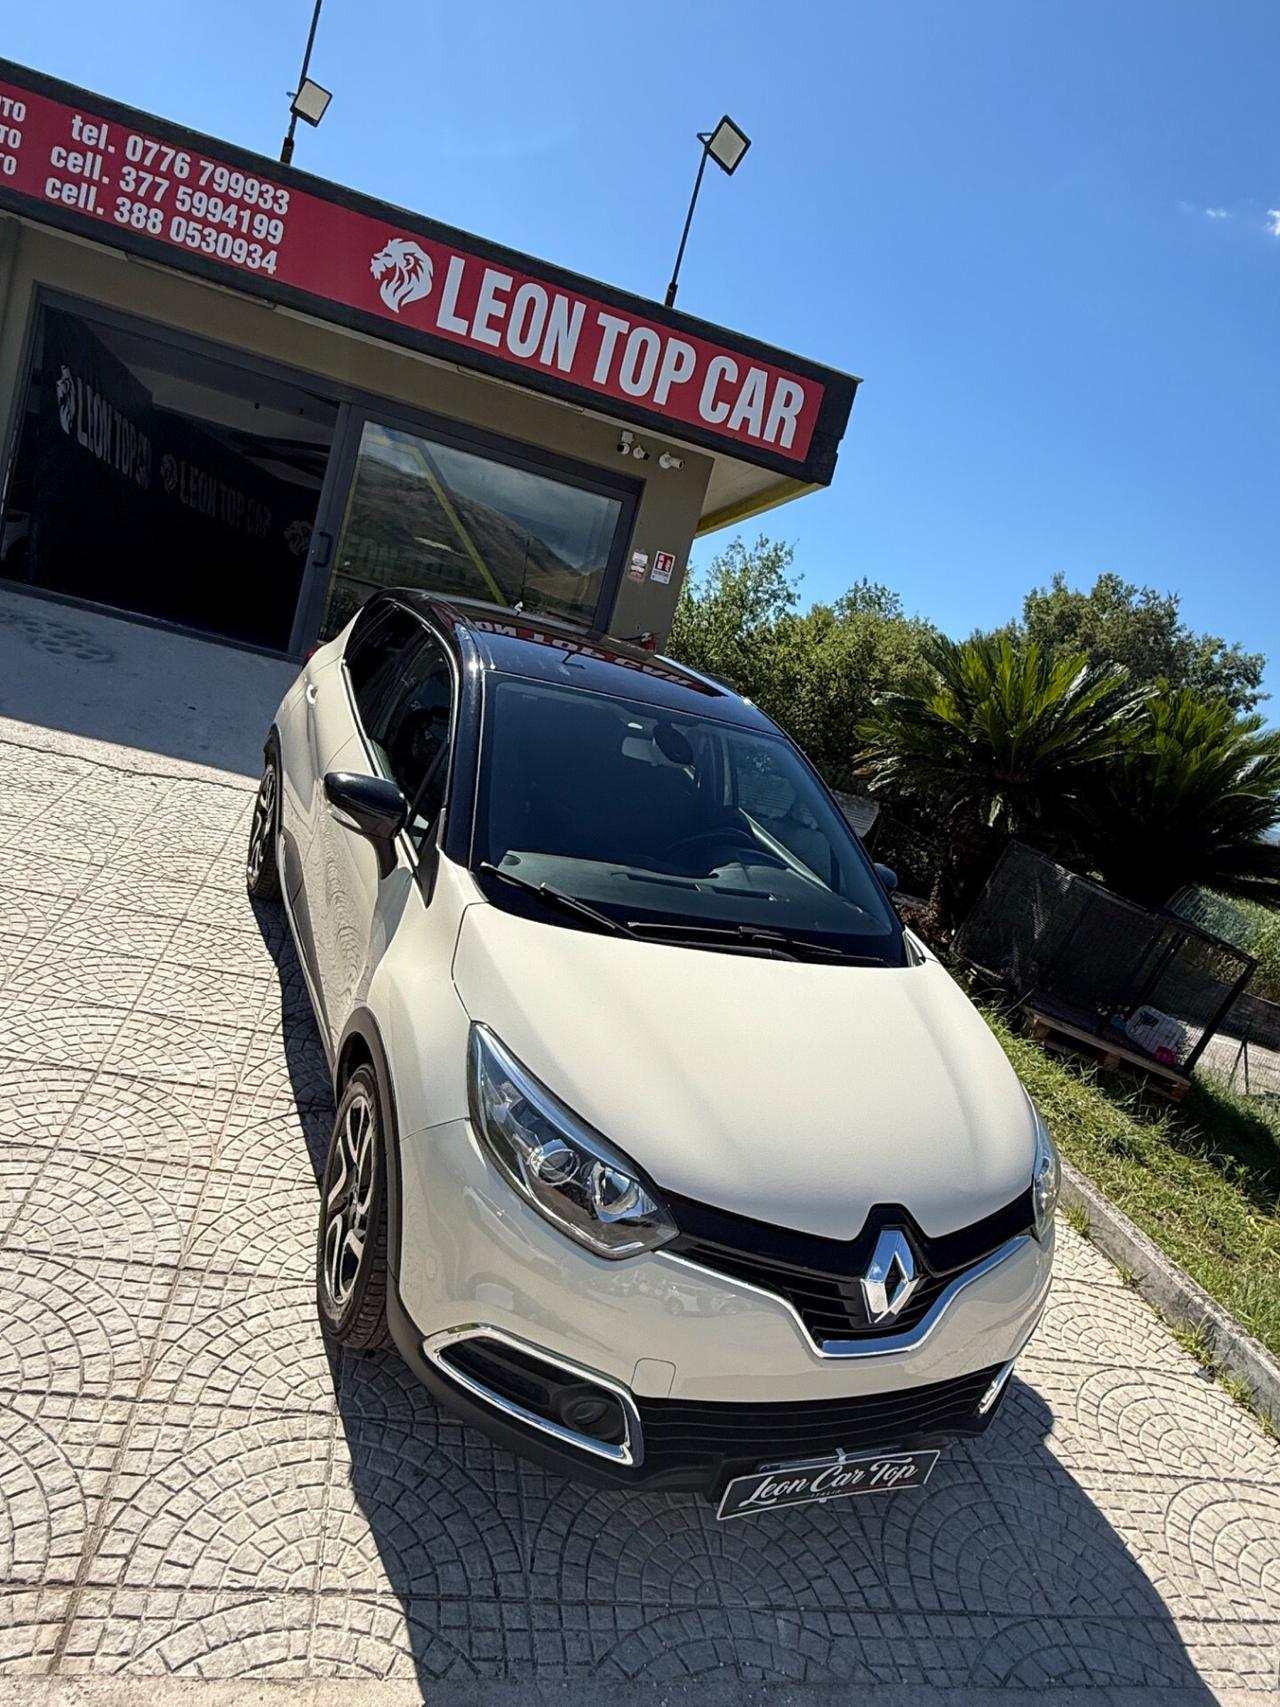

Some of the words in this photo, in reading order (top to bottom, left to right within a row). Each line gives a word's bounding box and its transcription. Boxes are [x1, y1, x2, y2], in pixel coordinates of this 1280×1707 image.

[0, 96, 26, 122] TO
[50, 146, 109, 185] cell.
[119, 166, 170, 203] 377
[175, 185, 284, 245] 5994199
[71, 114, 115, 153] tel.
[126, 135, 191, 179] 0776
[199, 160, 290, 215] 799933
[45, 177, 104, 215] cell.
[113, 197, 164, 234] 388
[169, 216, 278, 275] 0530934
[435, 255, 587, 373] LEON
[592, 311, 697, 406] TOP
[698, 355, 806, 450] CAR
[738, 1475, 810, 1508] Leon
[810, 1465, 865, 1493] Car
[869, 1456, 919, 1487] Top
